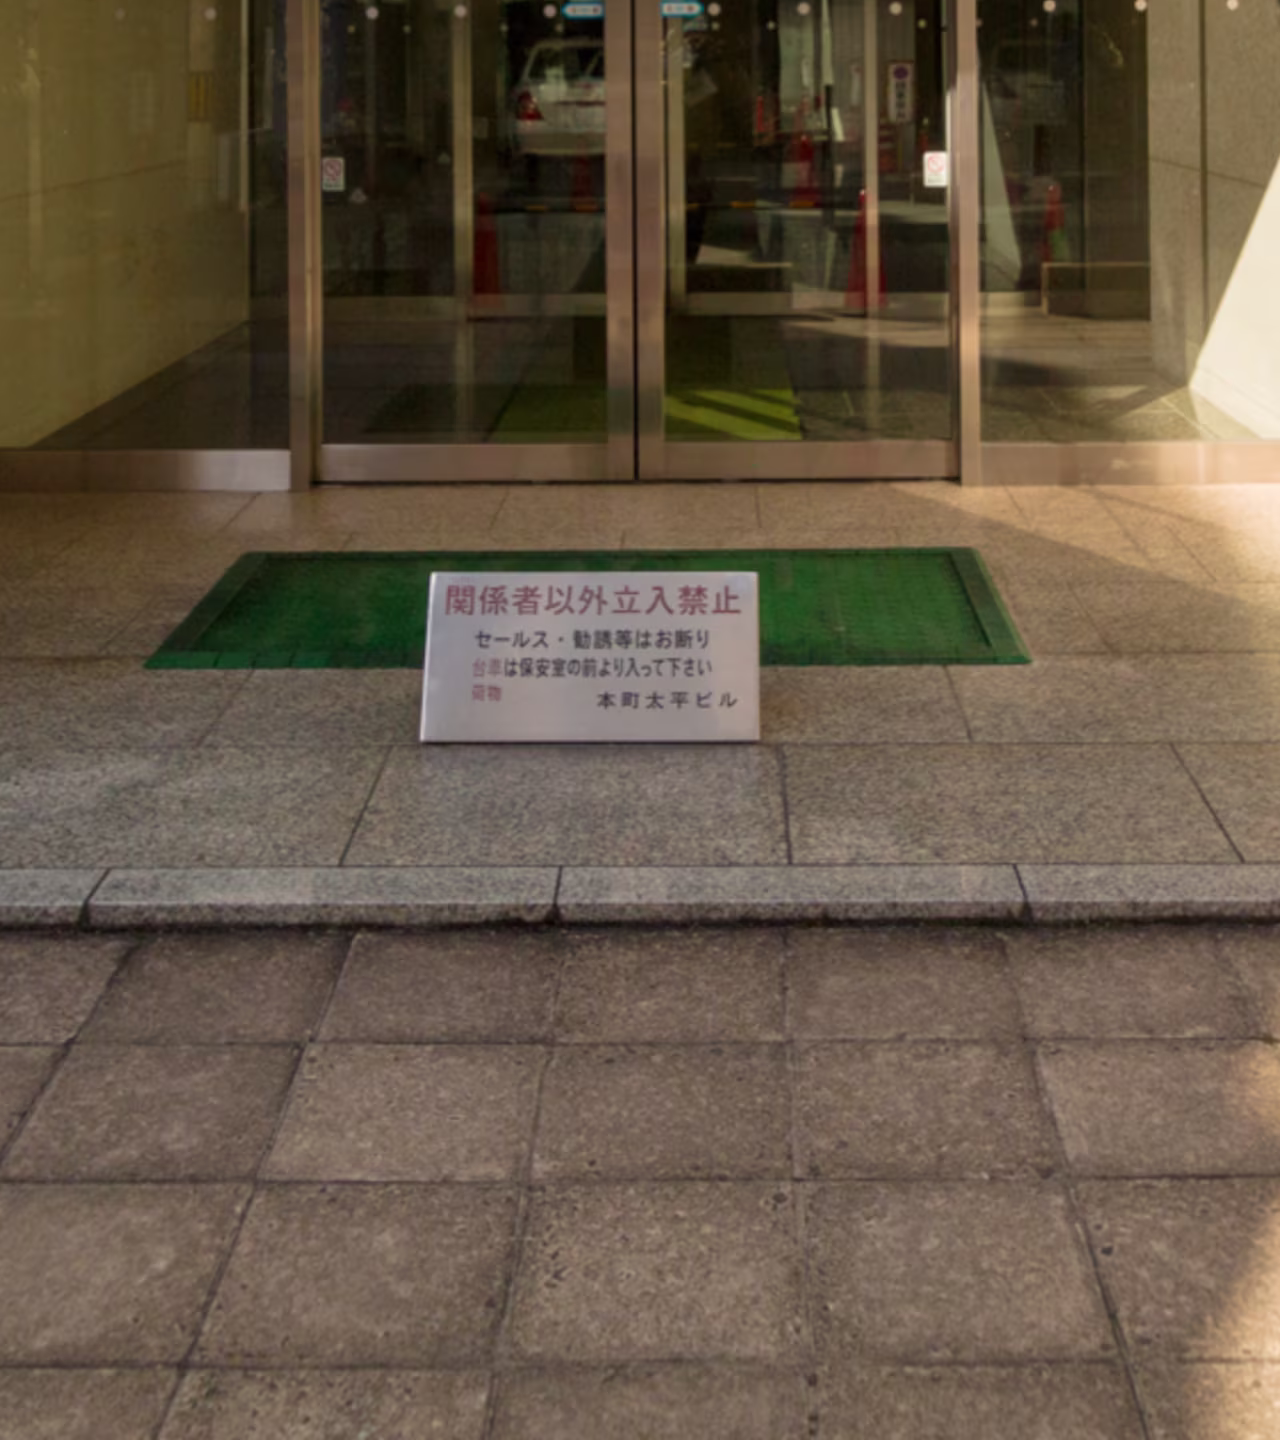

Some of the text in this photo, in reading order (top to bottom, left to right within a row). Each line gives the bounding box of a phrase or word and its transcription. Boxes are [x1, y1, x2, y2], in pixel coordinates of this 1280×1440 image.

[445, 584, 742, 616] 関係者以外立入禁止
[596, 691, 738, 710] 本町太平ビル
